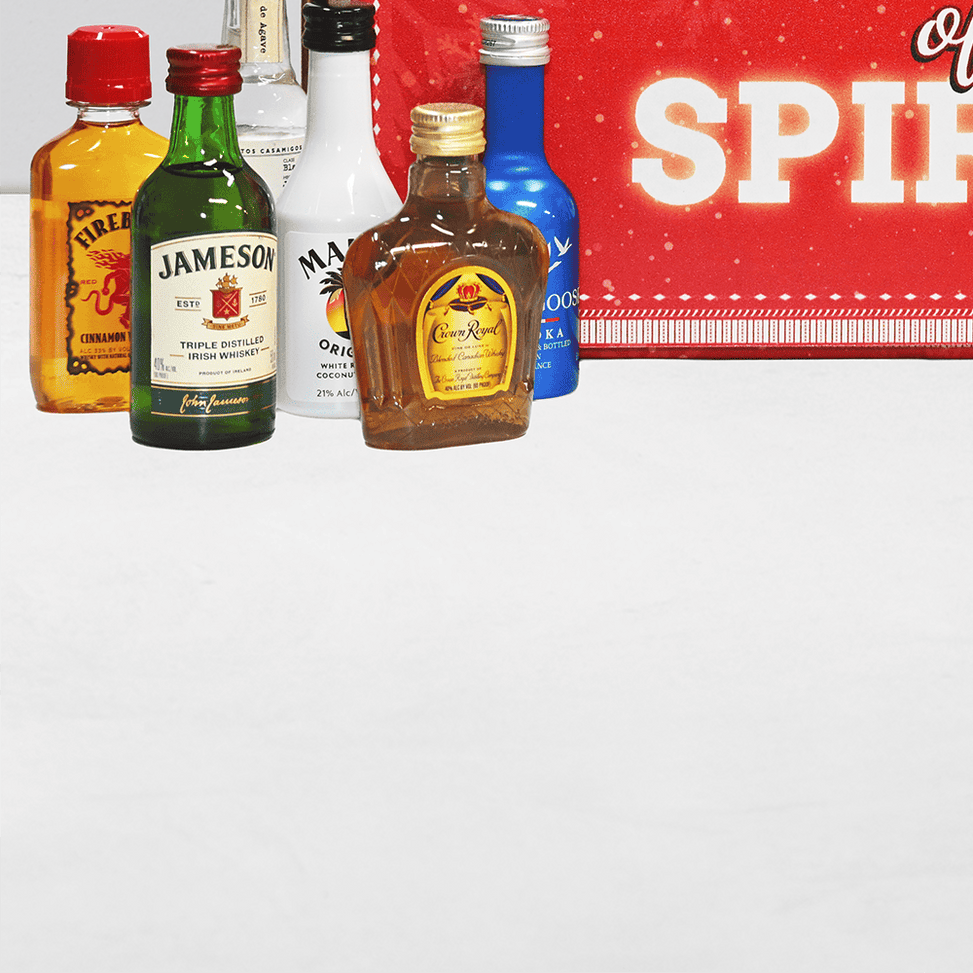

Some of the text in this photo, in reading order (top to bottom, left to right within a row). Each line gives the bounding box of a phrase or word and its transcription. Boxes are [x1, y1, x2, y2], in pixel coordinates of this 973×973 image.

[259, 5, 268, 18] de
[258, 22, 268, 54] Agave
[260, 145, 303, 154] CASAMIGOS
[73, 211, 131, 250] FIREB
[158, 244, 275, 280] JAMESON
[251, 294, 267, 304] 1780
[543, 287, 579, 312] OOS
[80, 332, 126, 344] CINNAMON
[432, 319, 503, 344] Crown Royal
[539, 327, 564, 340] KA
[180, 335, 265, 350] TRIPLE DISTILLED
[543, 339, 571, 351] BOTTLED
[188, 352, 217, 361] IRISH
[219, 347, 260, 361] WHISKEY
[316, 371, 357, 379] COCONU
[316, 389, 334, 398] 21%
[179, 394, 207, 413] John
